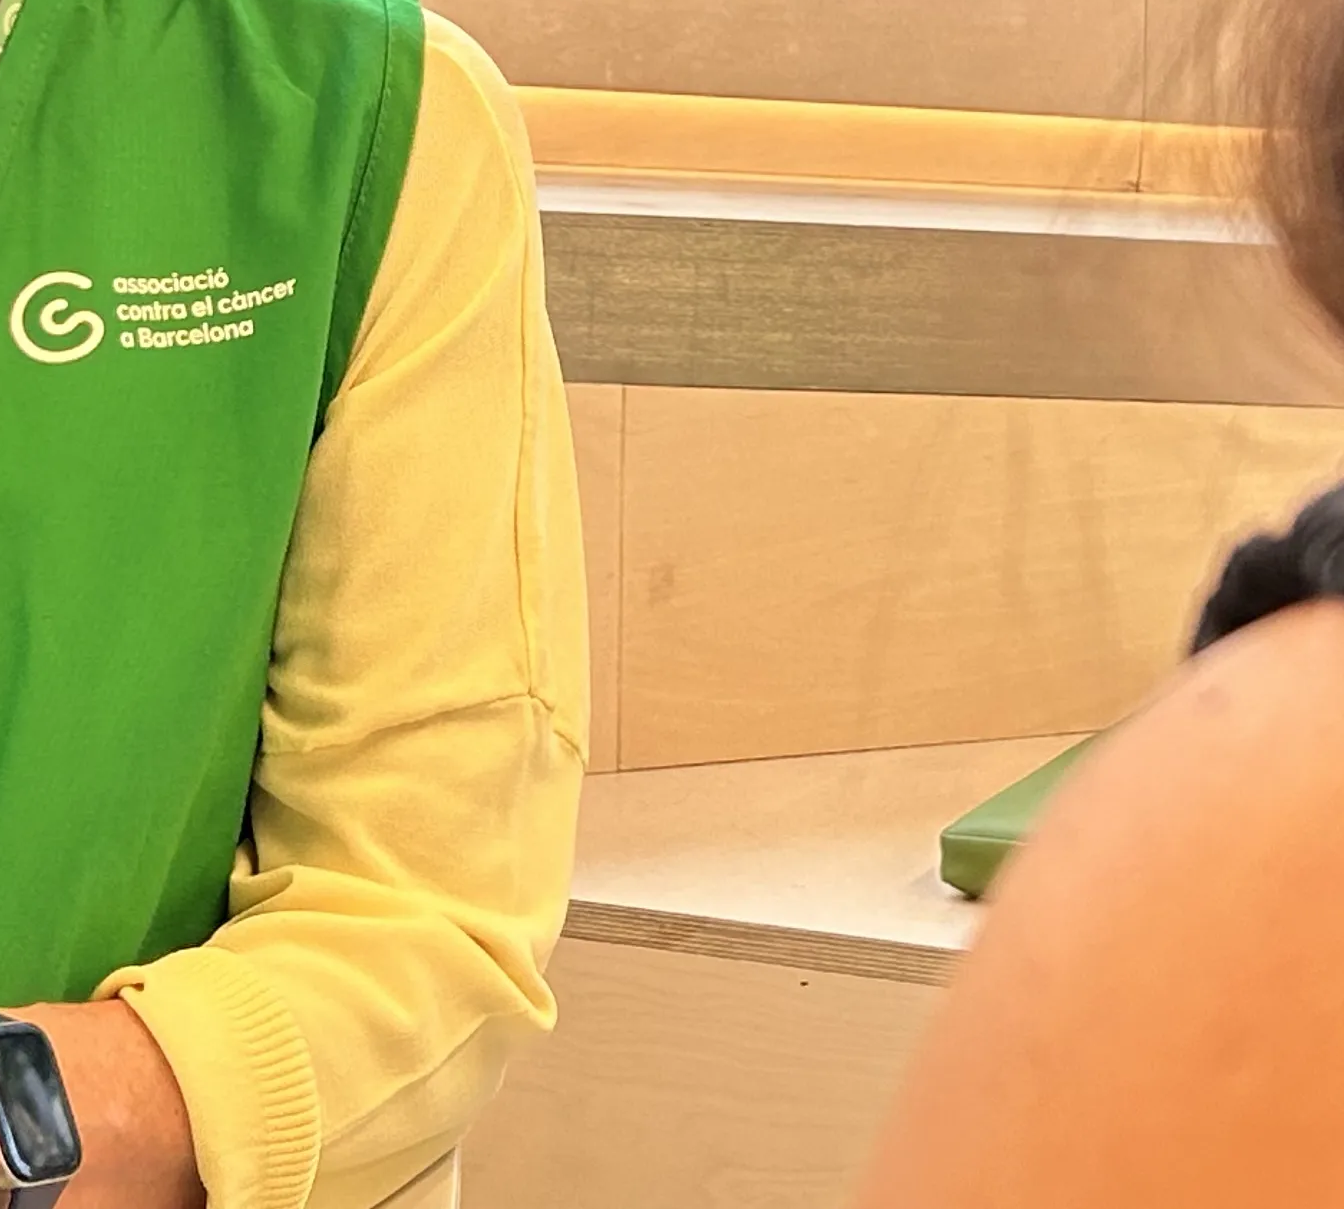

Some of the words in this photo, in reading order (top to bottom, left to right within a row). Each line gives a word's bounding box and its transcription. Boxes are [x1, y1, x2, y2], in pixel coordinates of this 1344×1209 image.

[112, 266, 230, 295] associació
[116, 300, 188, 322] contra
[190, 294, 214, 318] el
[217, 277, 297, 314] càncer
[119, 330, 135, 348] a
[137, 318, 254, 349] Barcelona
